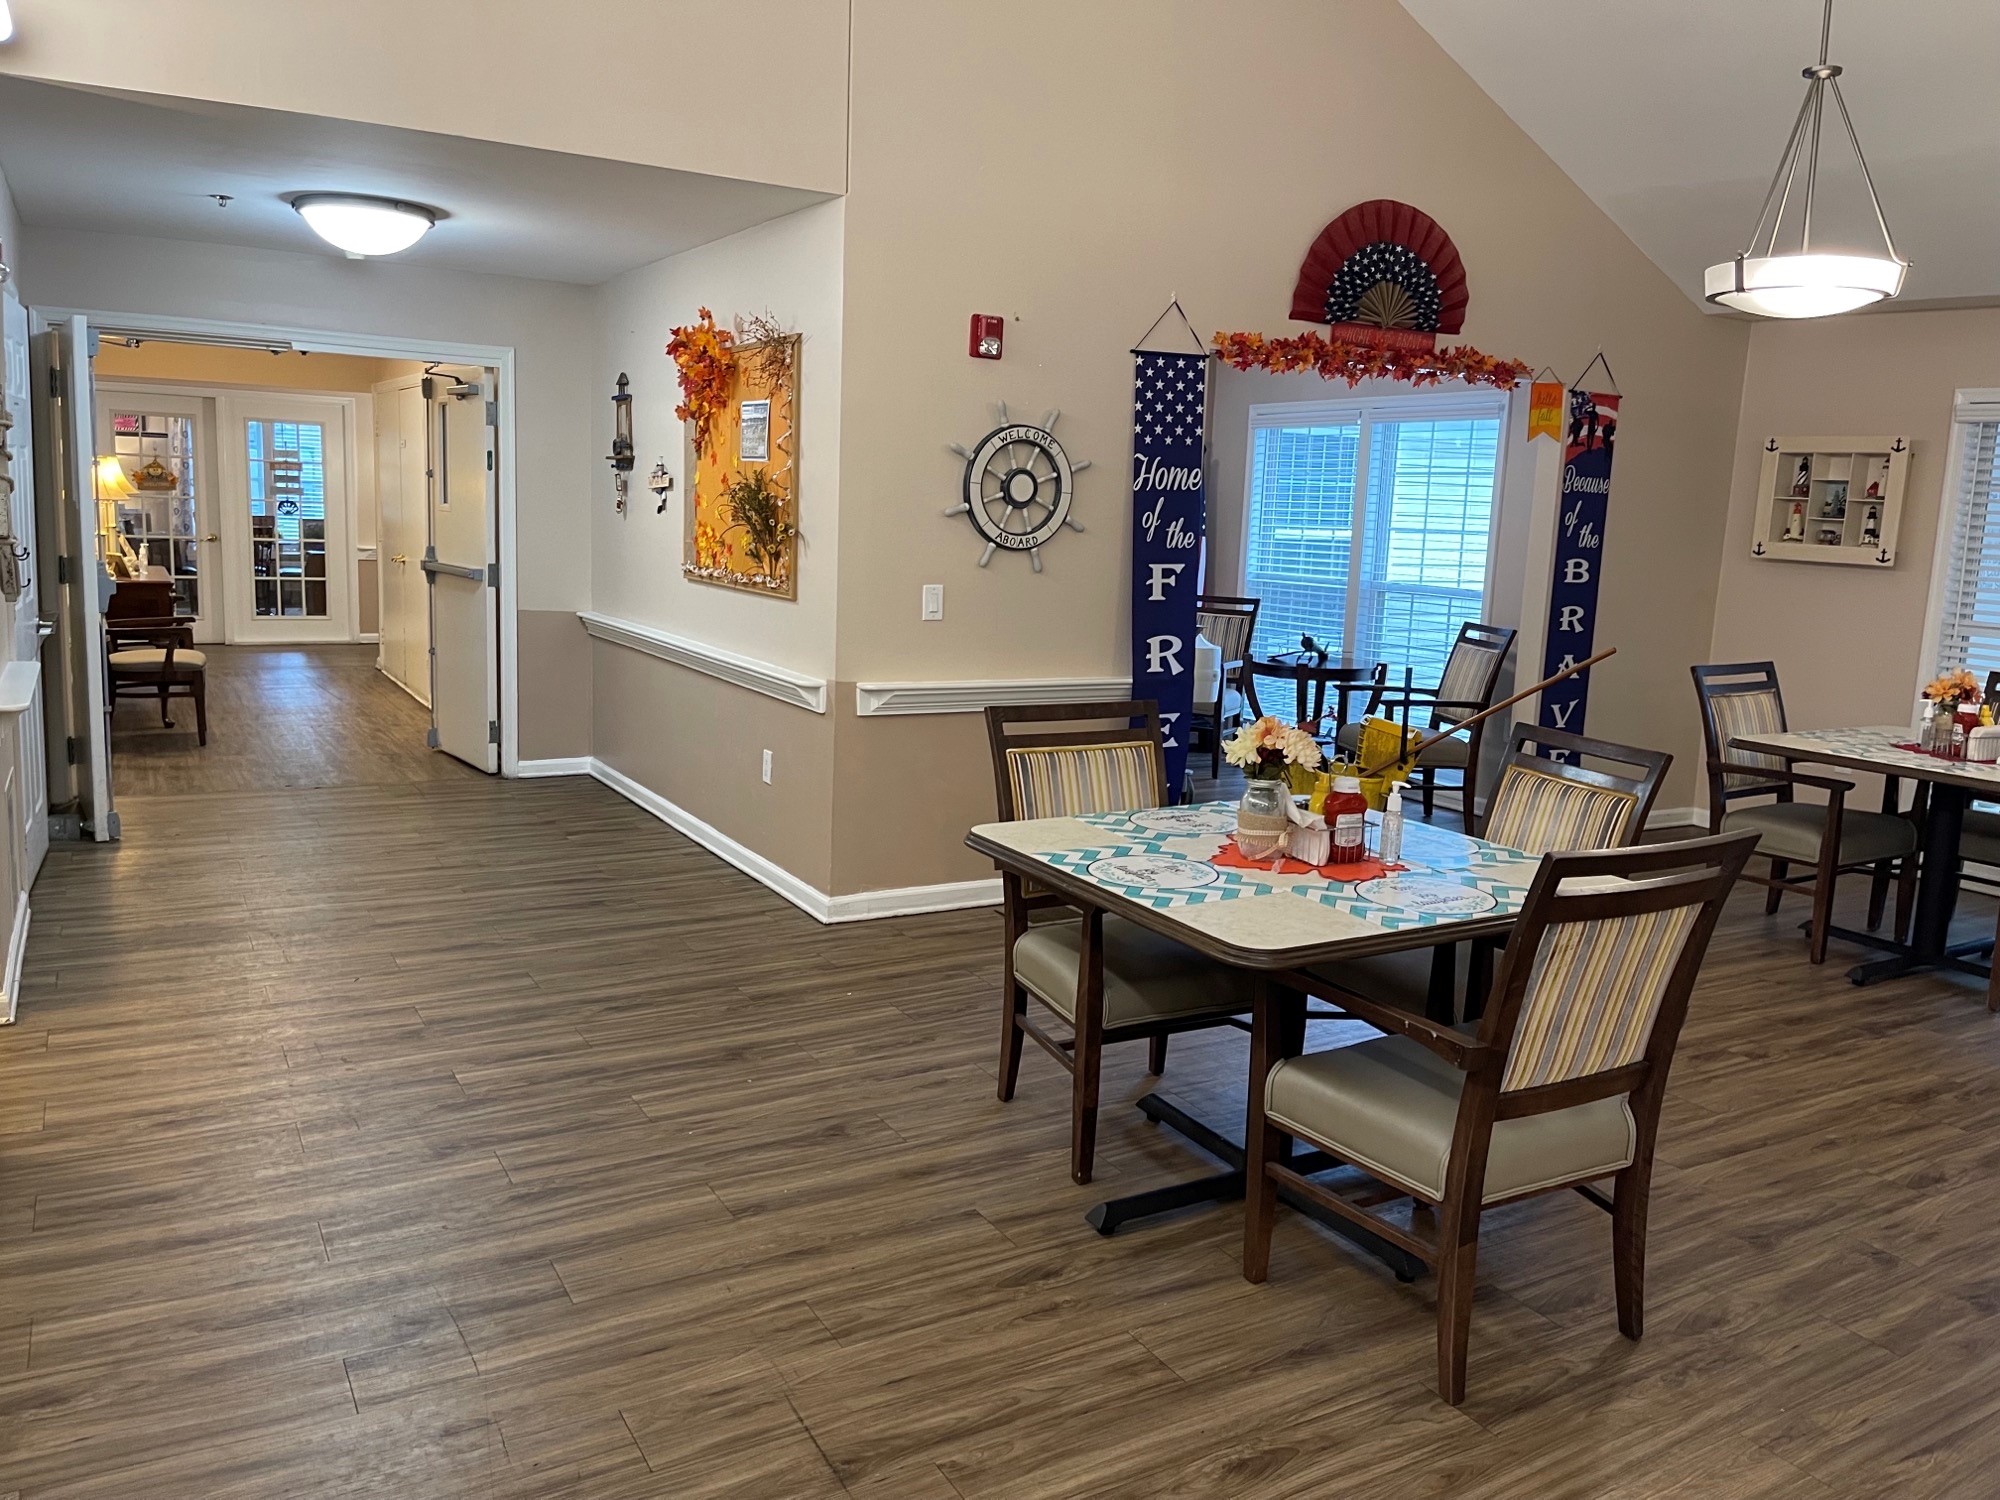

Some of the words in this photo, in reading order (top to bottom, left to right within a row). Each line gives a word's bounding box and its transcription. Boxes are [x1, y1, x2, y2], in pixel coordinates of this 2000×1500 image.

[998, 428, 1056, 450] WELCOME
[1133, 452, 1202, 491] Home
[1563, 464, 1610, 494] Because
[995, 532, 1039, 548] ABOARD
[1142, 496, 1165, 542] of
[1166, 517, 1196, 549] the
[1564, 500, 1582, 538] of
[1578, 521, 1600, 549] the
[1145, 563, 1186, 749] FRE
